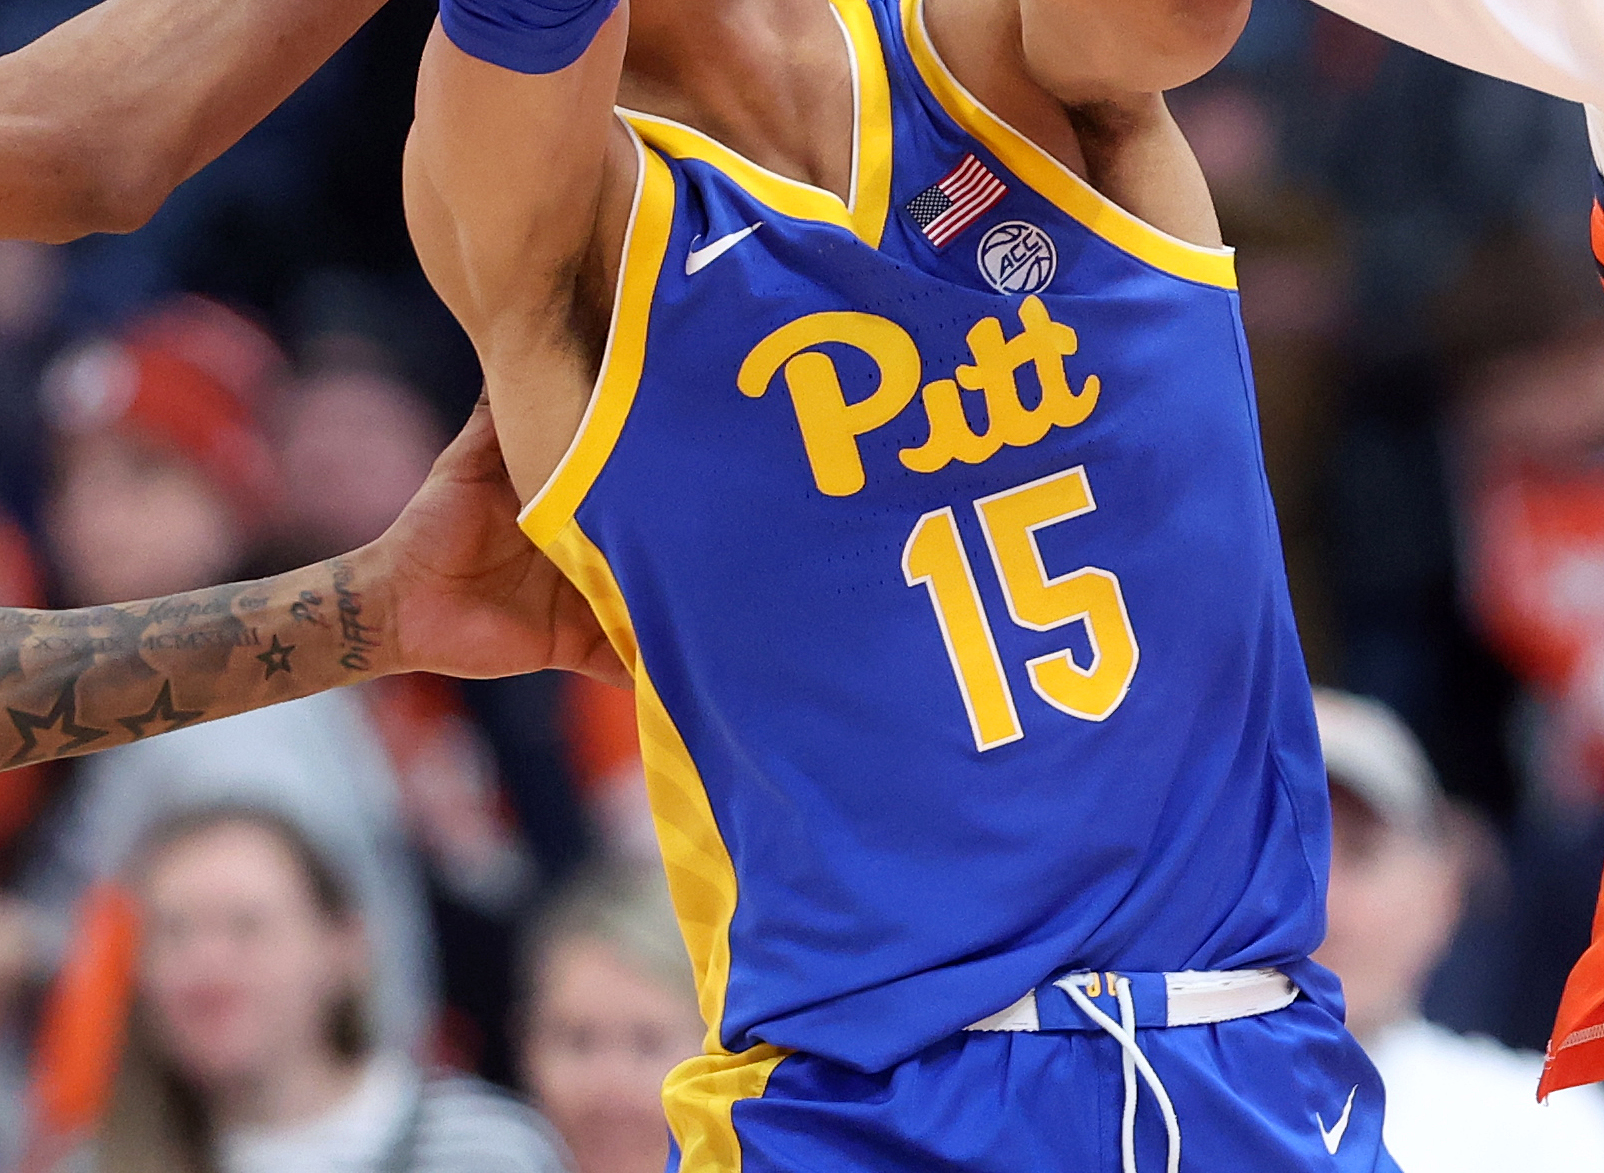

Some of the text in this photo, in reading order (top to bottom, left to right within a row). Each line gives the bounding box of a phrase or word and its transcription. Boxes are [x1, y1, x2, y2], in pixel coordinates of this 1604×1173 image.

[1000, 229, 1040, 280] ACC
[736, 295, 1100, 497] Pitt
[901, 464, 1140, 753] 15
